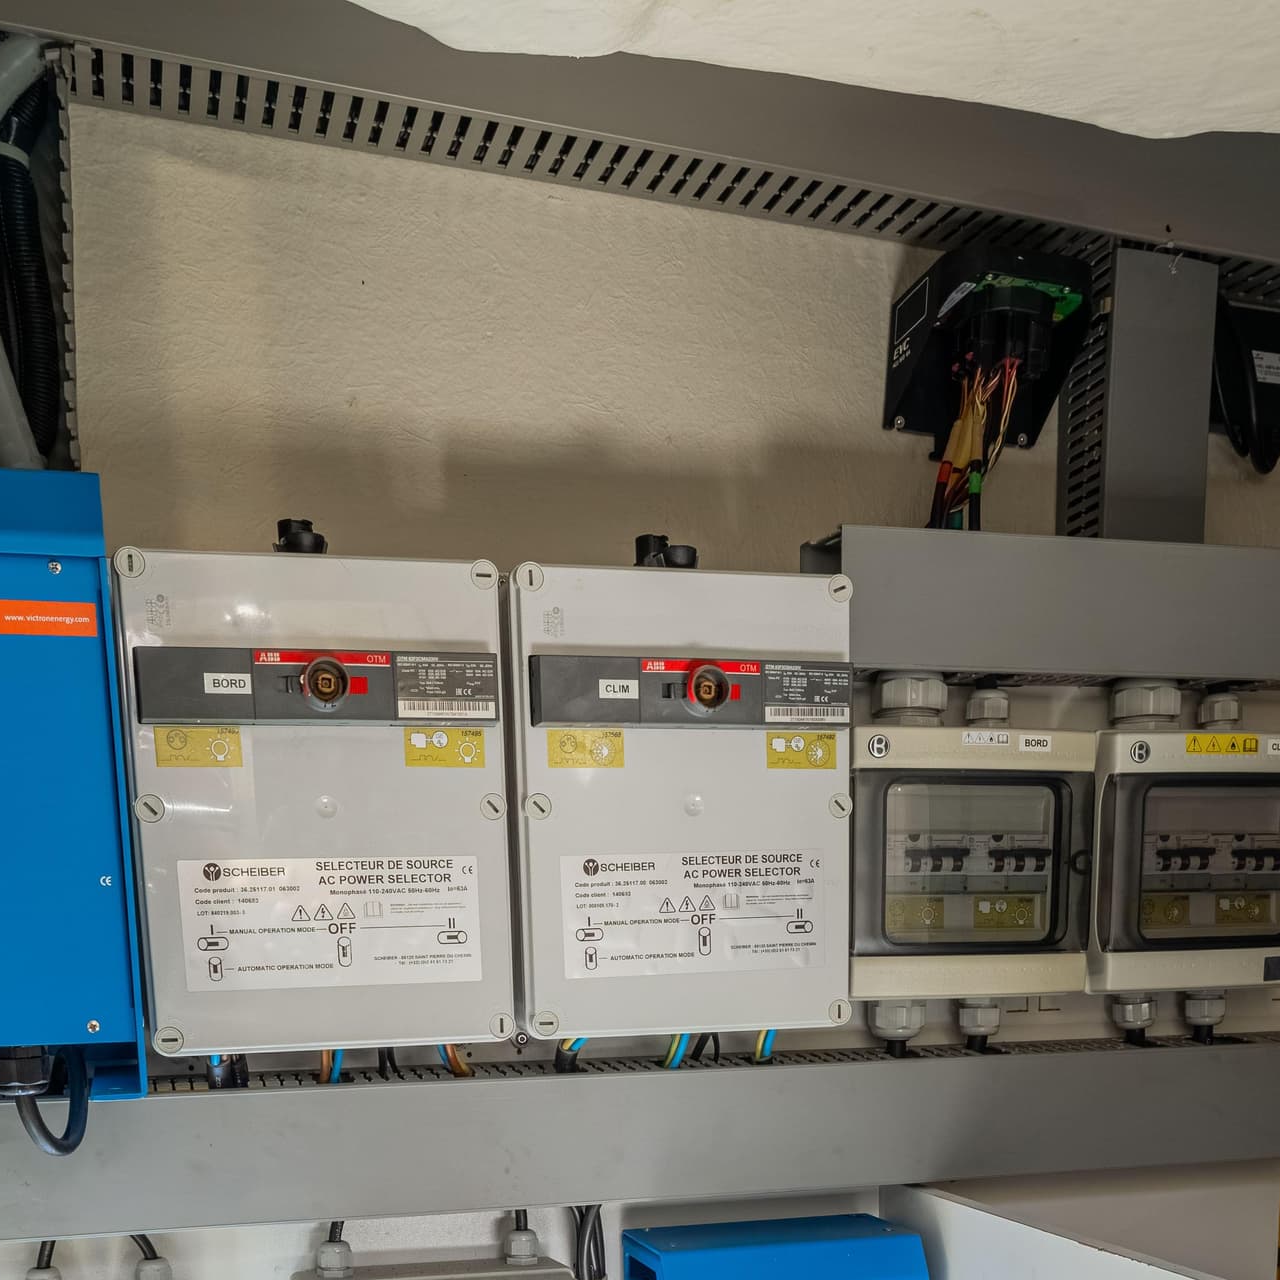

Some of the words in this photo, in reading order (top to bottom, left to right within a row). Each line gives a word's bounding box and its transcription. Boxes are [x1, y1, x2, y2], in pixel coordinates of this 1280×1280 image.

[259, 652, 281, 662] ABB
[366, 654, 386, 663] OTM
[646, 661, 665, 670] ABB
[739, 664, 757, 672] OTM
[212, 678, 247, 689] BORD
[605, 684, 630, 694] CLIM
[1024, 738, 1048, 749] BORD
[315, 860, 385, 871] SELECTEUR
[387, 860, 403, 870] DE
[406, 859, 454, 869] SOURCE
[681, 855, 742, 866] SELECTEUR
[745, 855, 759, 864] DE
[761, 854, 803, 863] SOURCE
[223, 867, 286, 877] SCHEIBER
[600, 862, 656, 872] SCHEIBER
[684, 870, 699, 879] AC
[702, 869, 742, 878] POWER
[744, 867, 801, 877] SELECTOR
[319, 875, 336, 885] AC
[339, 874, 384, 884] POWER
[388, 873, 452, 883] SELECTOR
[690, 913, 716, 925] OFF
[328, 922, 357, 934] OFF
